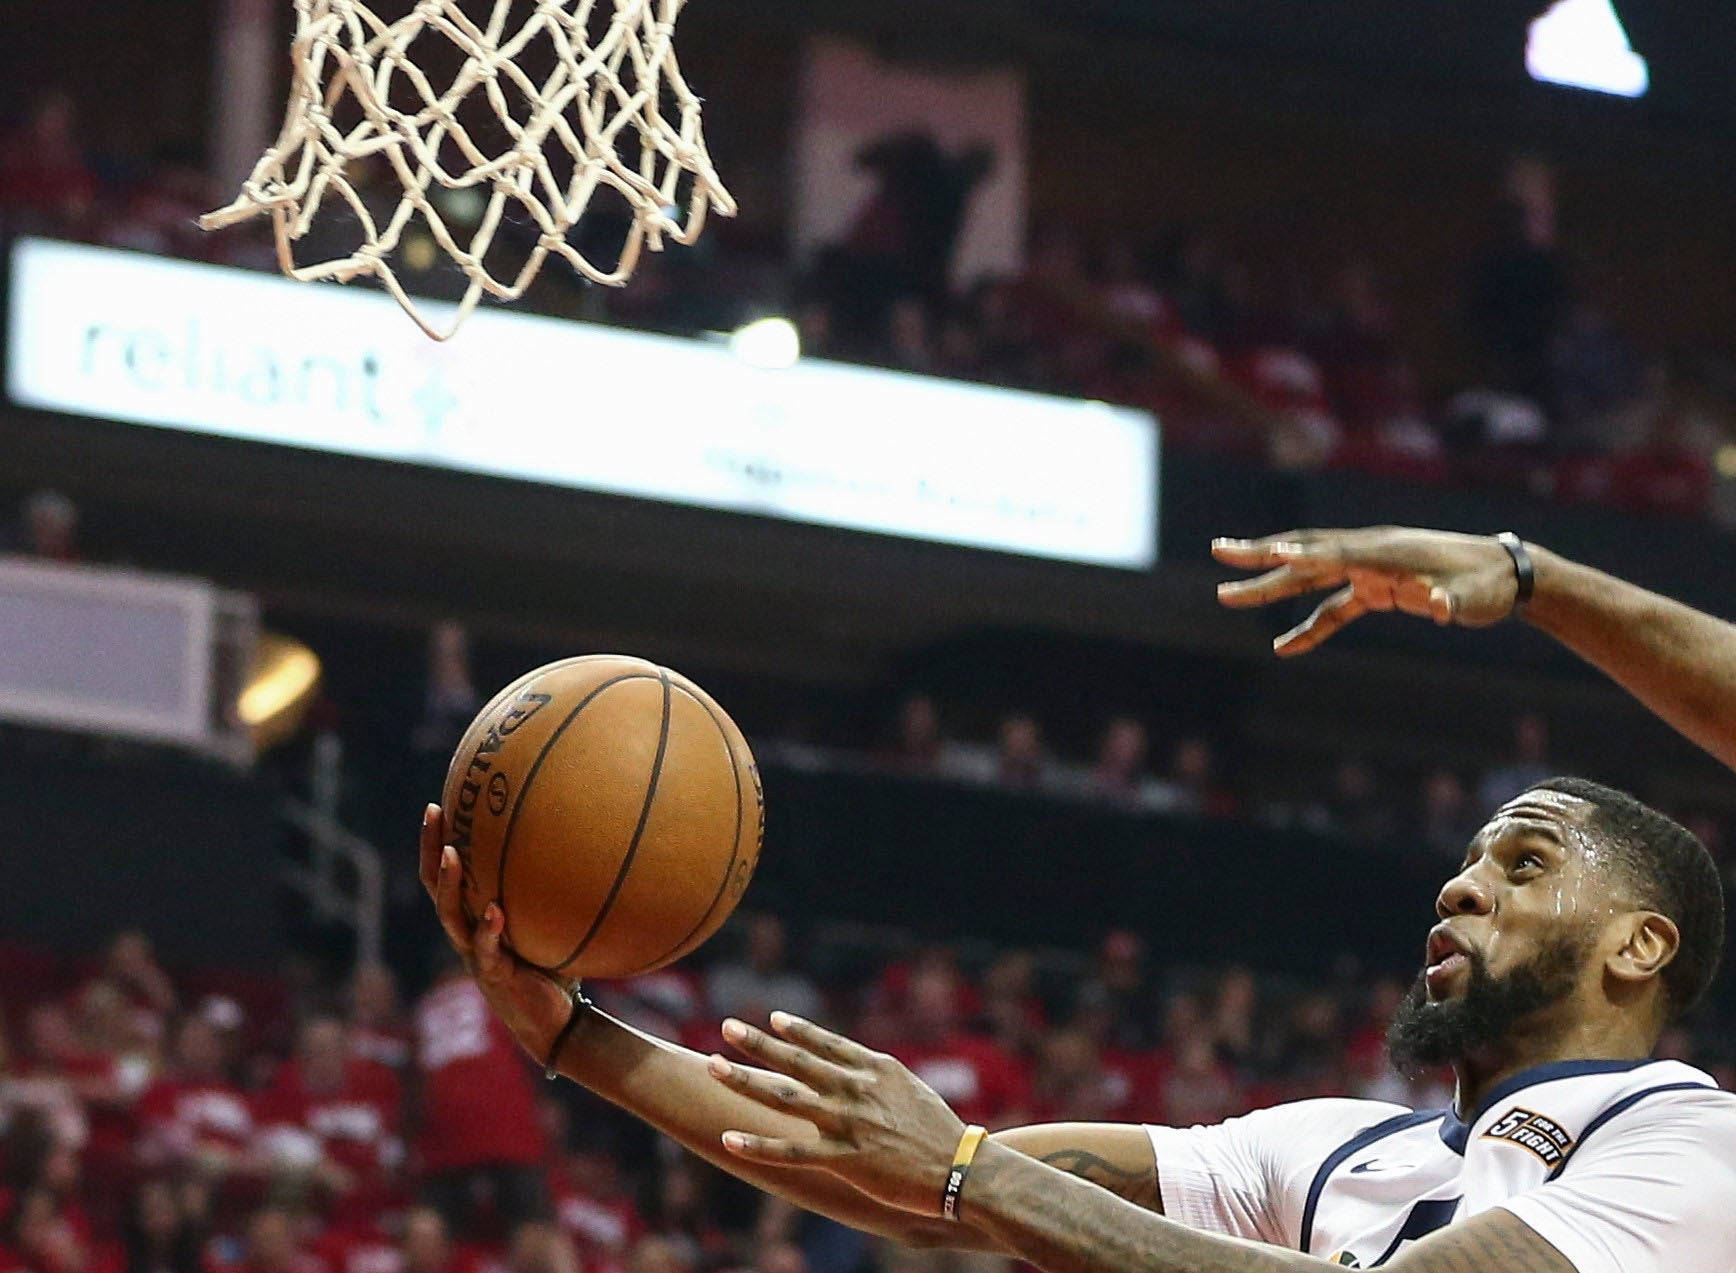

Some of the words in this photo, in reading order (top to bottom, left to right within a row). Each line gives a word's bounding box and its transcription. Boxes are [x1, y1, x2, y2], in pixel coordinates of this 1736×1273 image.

[80, 313, 393, 428] reliant
[1490, 1111, 1529, 1136] 5
[1511, 1128, 1559, 1161] FIGHT
